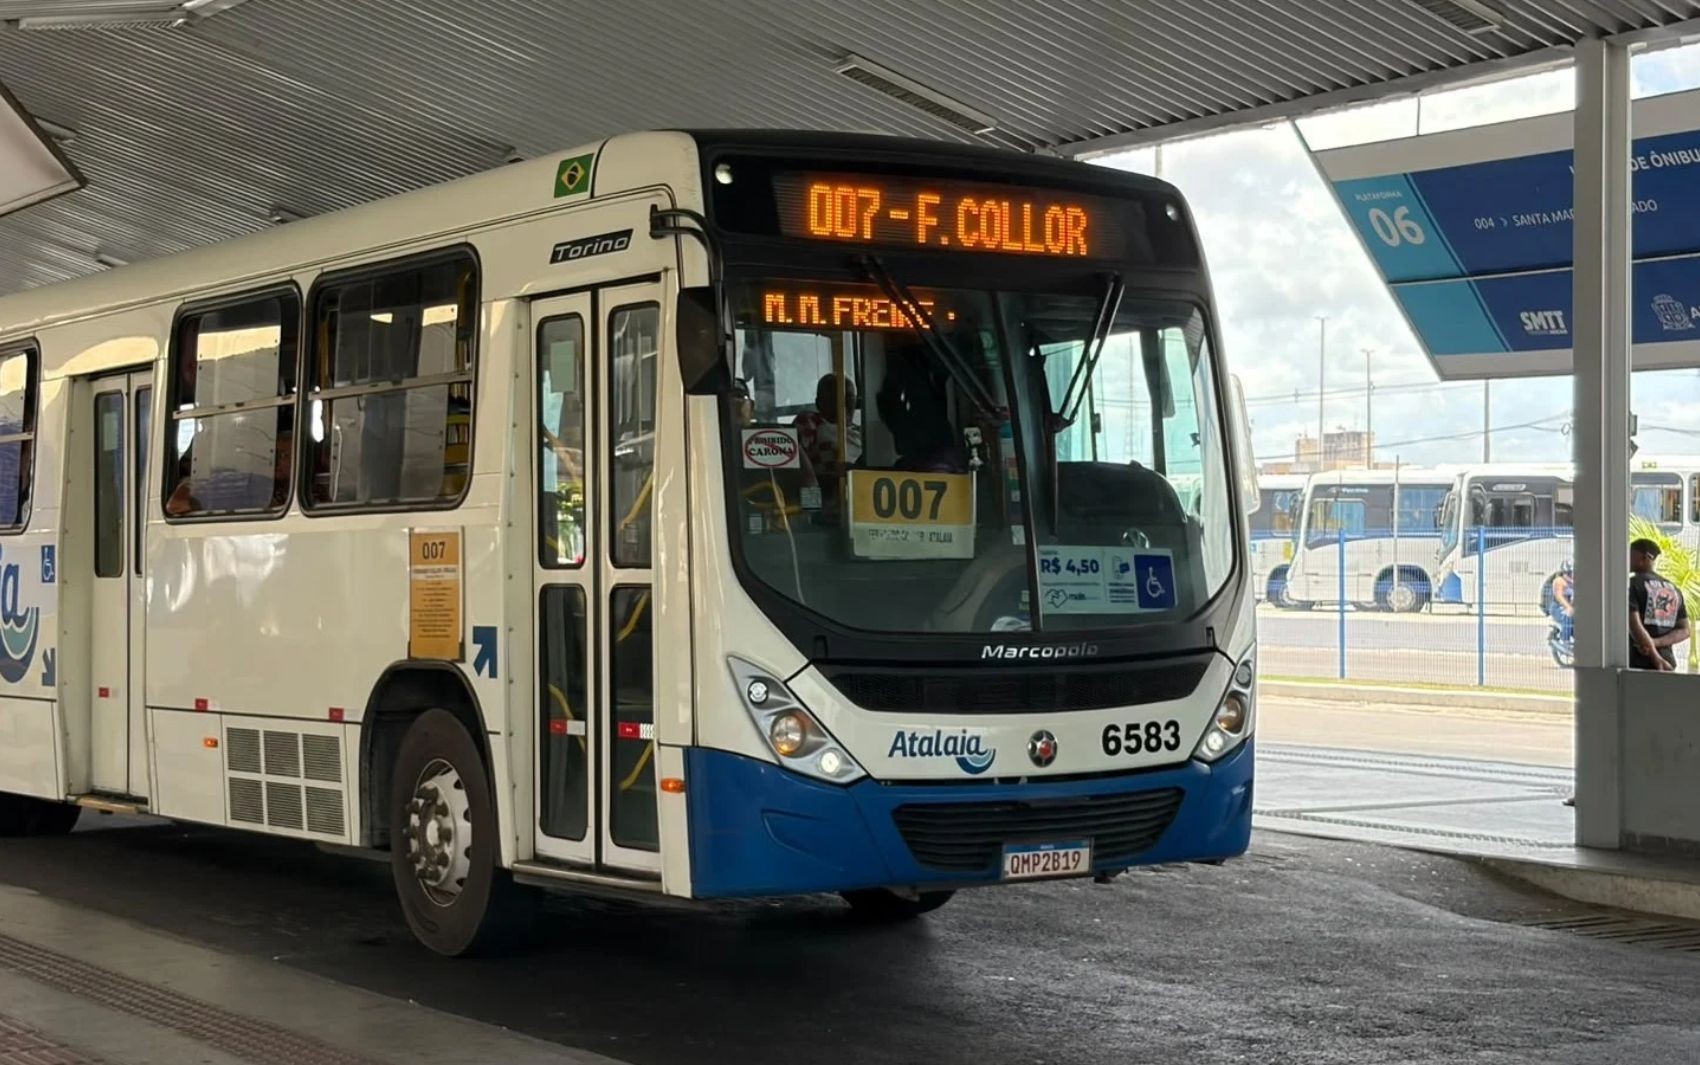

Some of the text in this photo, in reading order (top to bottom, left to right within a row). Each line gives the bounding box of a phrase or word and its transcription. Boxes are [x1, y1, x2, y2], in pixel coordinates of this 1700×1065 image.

[1368, 205, 1425, 247] 06
[1474, 217, 1495, 230] 004
[1512, 212, 1551, 227] SANTA
[554, 238, 628, 260] Torino
[1520, 310, 1566, 331] SMTT
[872, 477, 947, 520] 007
[422, 541, 446, 560] 007
[1041, 557, 1100, 576] R$ 4,50
[981, 642, 1098, 660] Marcopolo
[888, 728, 990, 758] Atalaia
[1102, 719, 1181, 757] 6583
[1010, 850, 1081, 875] QMP2B19
